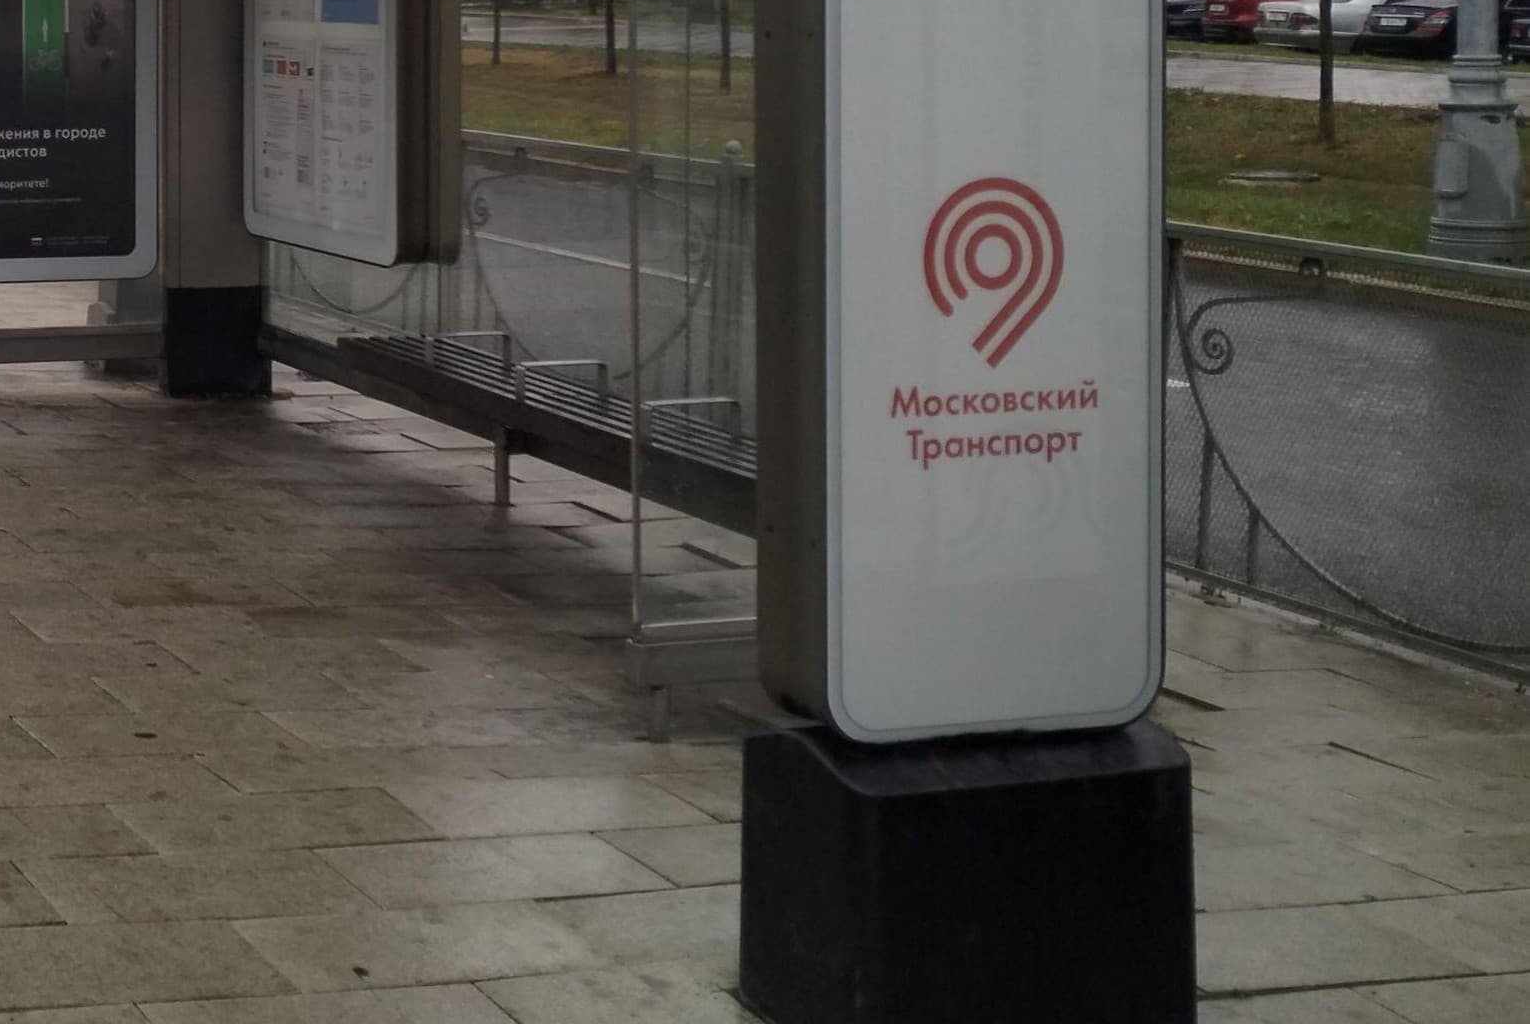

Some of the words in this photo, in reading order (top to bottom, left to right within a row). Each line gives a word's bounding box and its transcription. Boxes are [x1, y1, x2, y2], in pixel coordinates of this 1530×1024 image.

[43, 129, 51, 139] в
[55, 127, 107, 141] городе
[890, 378, 1099, 418] Московский
[906, 429, 1083, 470] Транспорт
